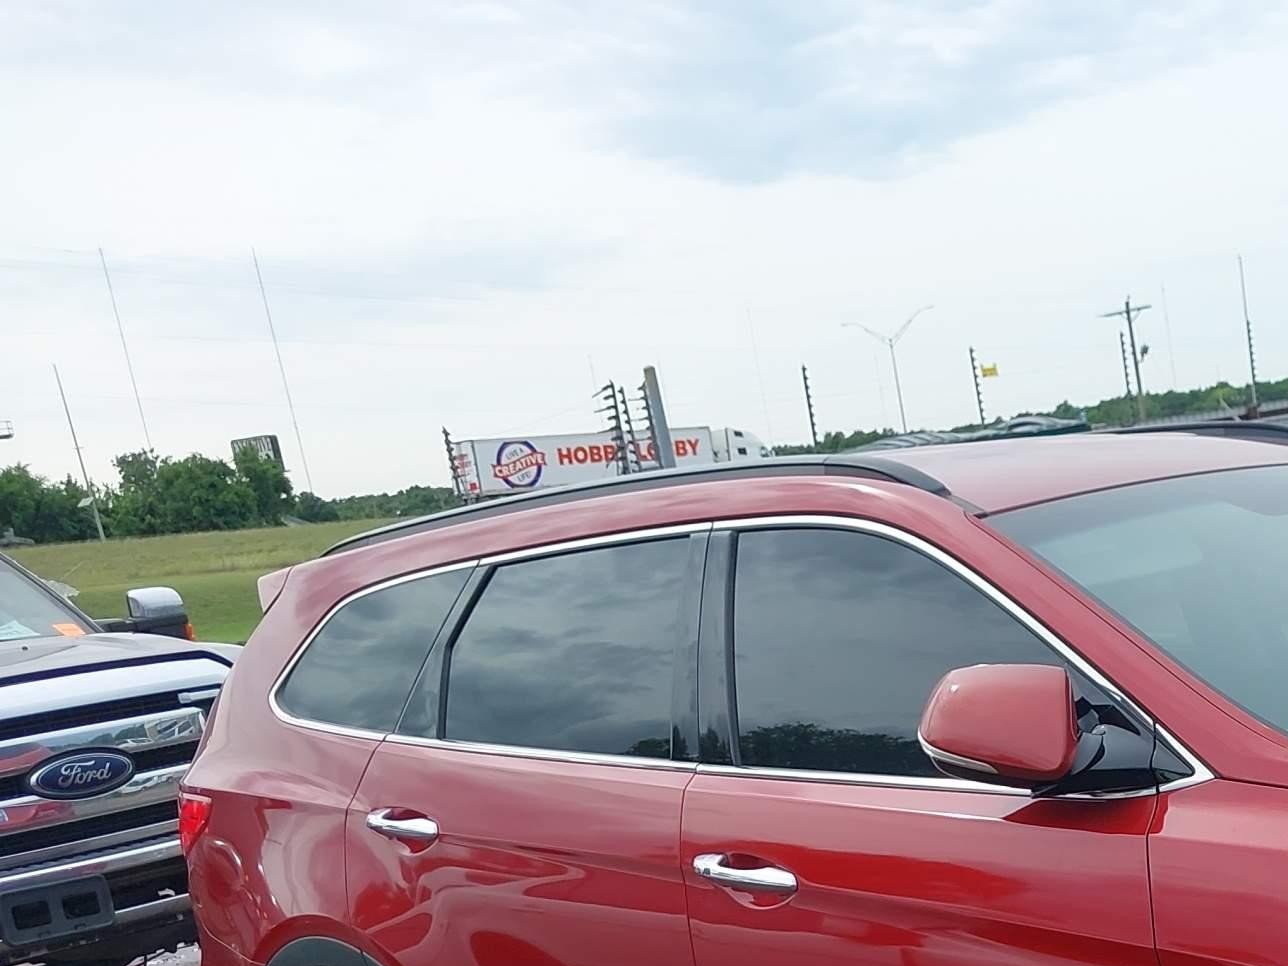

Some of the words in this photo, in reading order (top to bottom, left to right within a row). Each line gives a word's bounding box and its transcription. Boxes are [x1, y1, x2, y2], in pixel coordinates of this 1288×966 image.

[495, 453, 544, 477] CREATIVE
[557, 444, 618, 466] HOBB
[635, 439, 699, 463] LOBY
[58, 759, 112, 788] Ford
